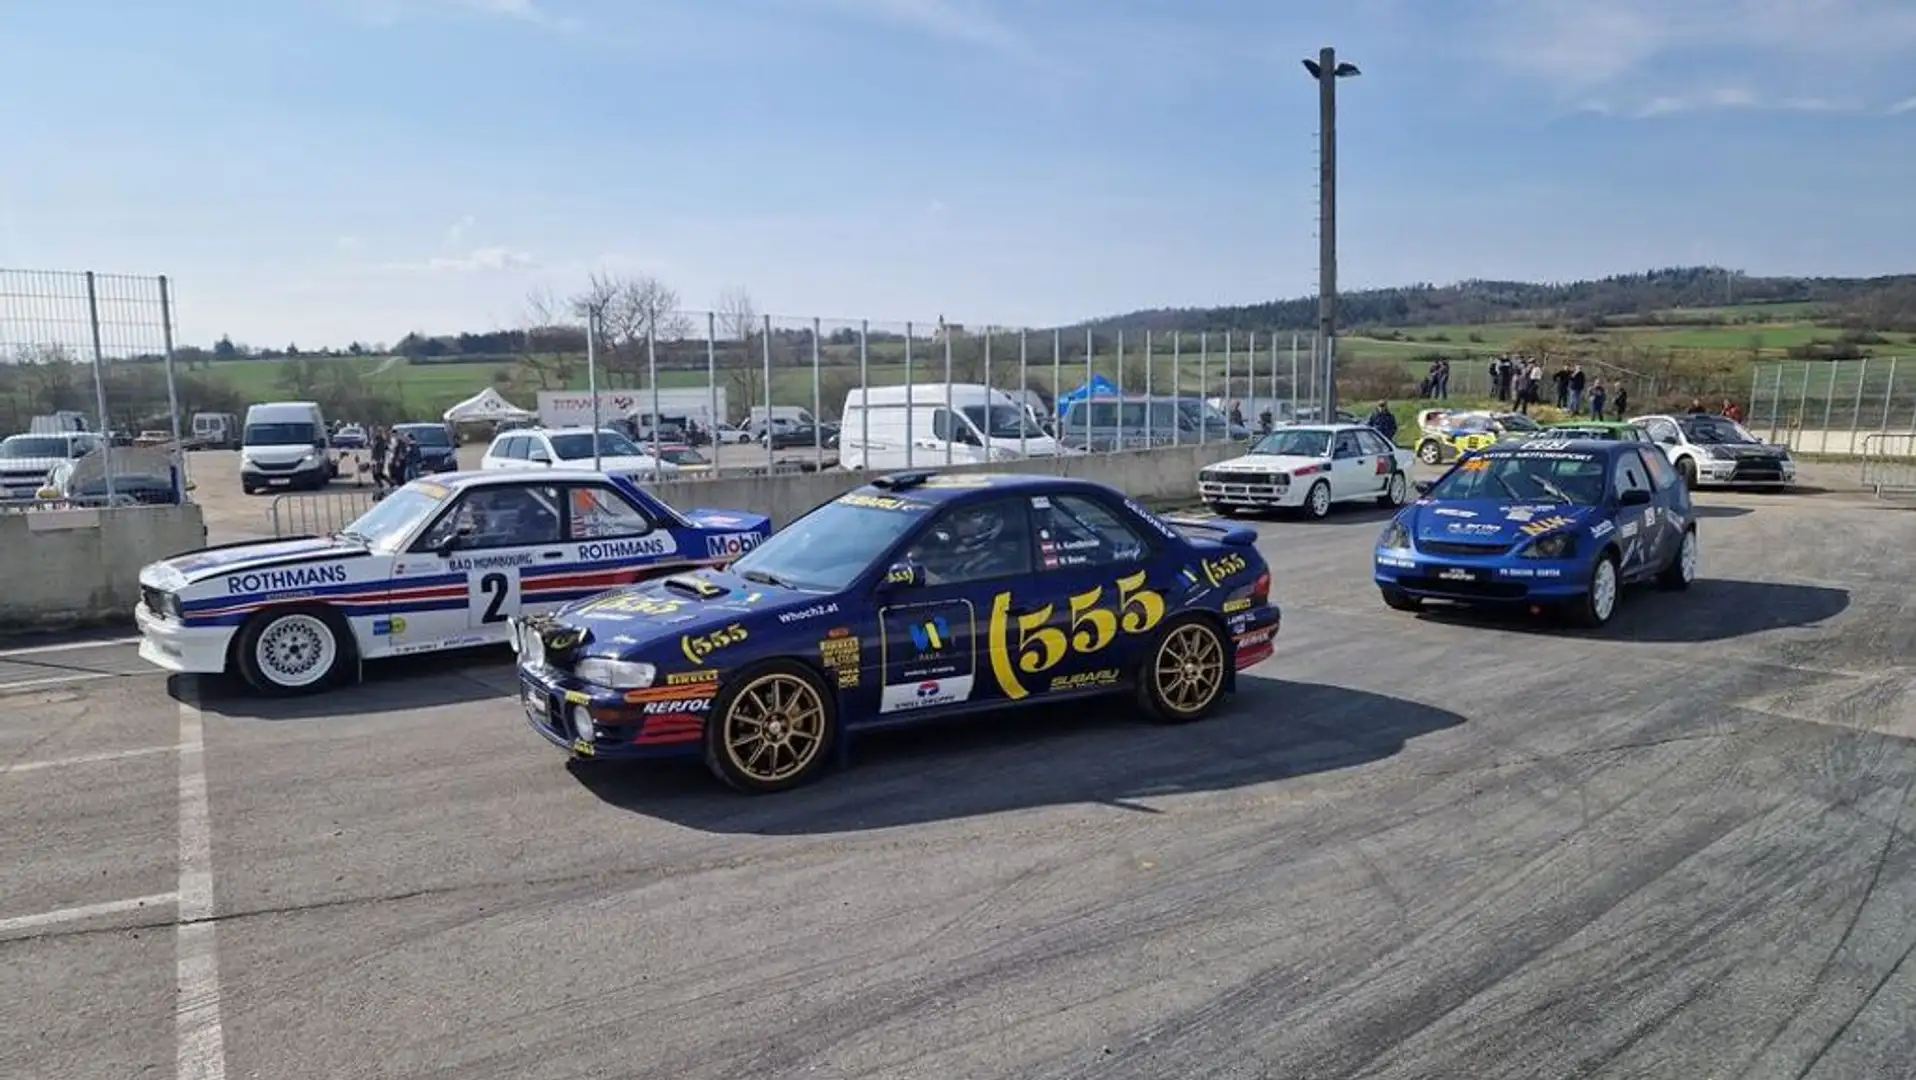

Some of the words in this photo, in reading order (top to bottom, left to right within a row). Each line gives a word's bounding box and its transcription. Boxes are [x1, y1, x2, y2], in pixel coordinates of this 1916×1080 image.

[578, 538, 664, 561] ROTHMANS
[708, 531, 763, 555] Mobil
[227, 564, 348, 594] ROTHMANS
[481, 572, 509, 625] 2
[643, 698, 712, 714] REPSOL
